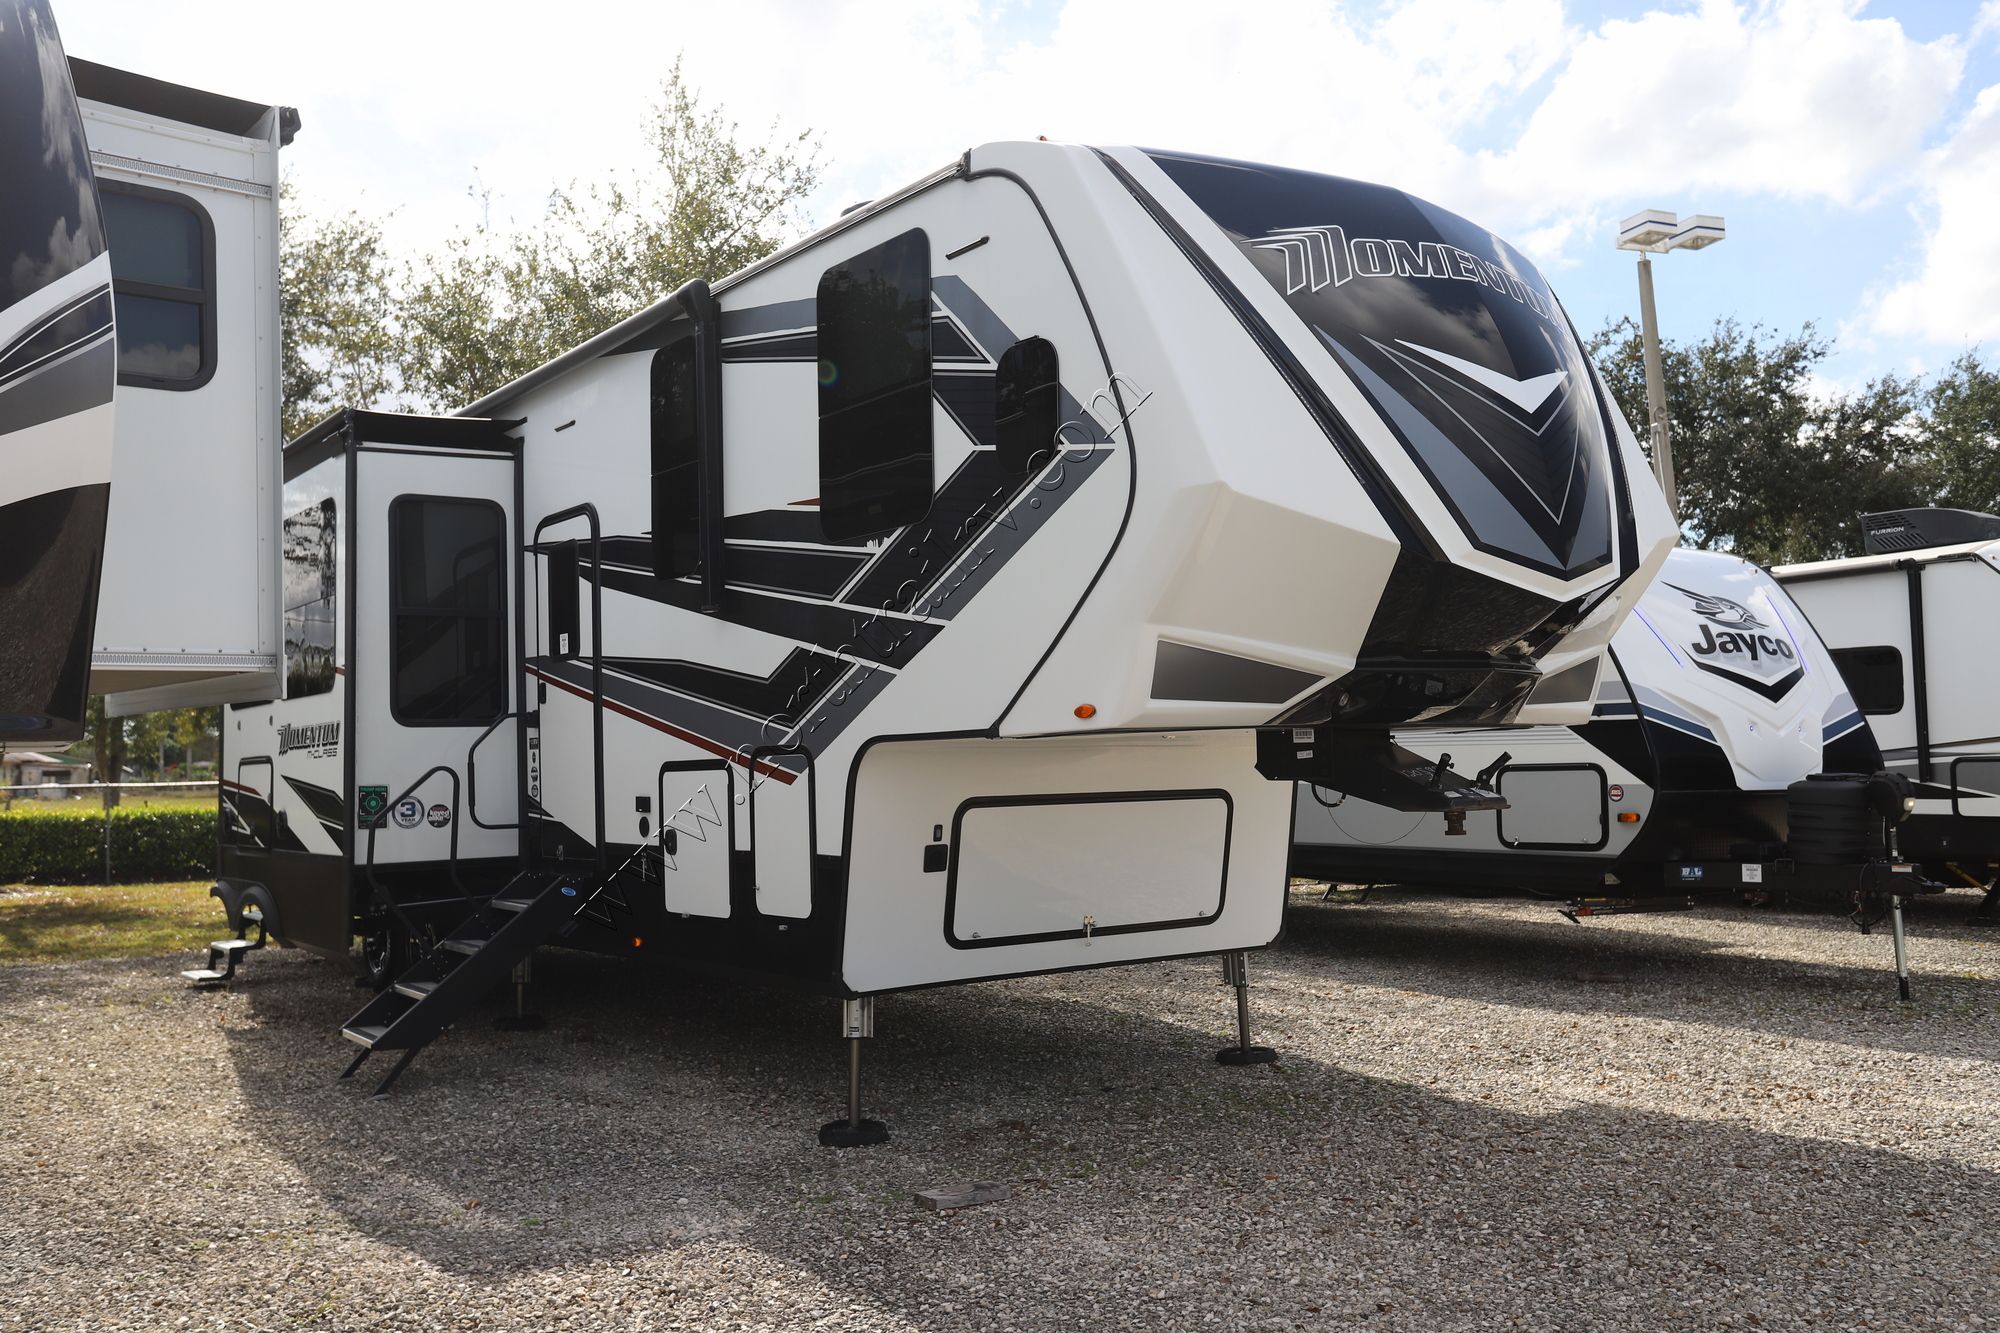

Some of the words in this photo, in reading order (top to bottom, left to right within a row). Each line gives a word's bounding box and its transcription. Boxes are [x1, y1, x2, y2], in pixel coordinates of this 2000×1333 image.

[1870, 526, 1905, 536] FURRION
[1692, 624, 1794, 661] Jayco
[277, 720, 341, 756] MOMENTUM
[400, 801, 416, 817] 3
